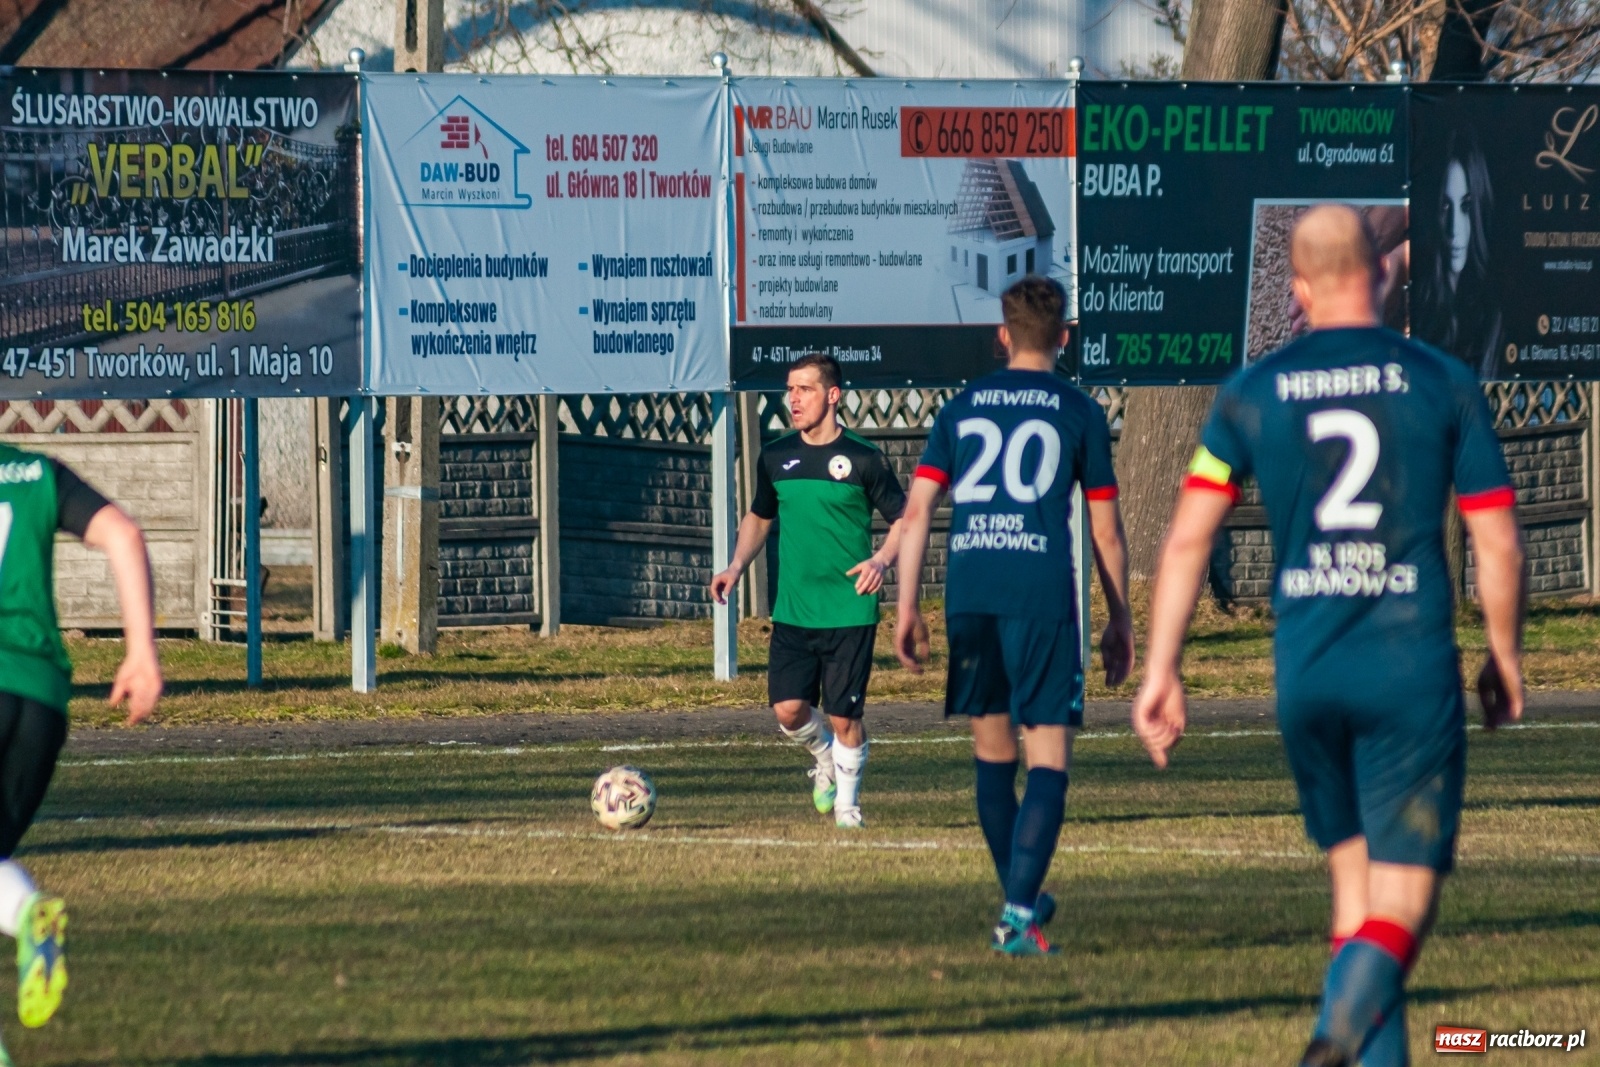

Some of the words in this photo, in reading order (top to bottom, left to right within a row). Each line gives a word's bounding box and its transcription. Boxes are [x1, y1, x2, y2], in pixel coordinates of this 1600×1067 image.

[11, 87, 319, 128] ŚLUSARSTWO-KOWALSTWO
[747, 106, 773, 129] MR
[776, 106, 812, 130] BAU
[817, 106, 859, 129] Marcin
[862, 106, 898, 129] Rusek
[1298, 103, 1395, 135] TWORKÓW
[938, 111, 974, 154] 666
[981, 111, 1018, 154] 859
[1026, 112, 1063, 154] 250
[1083, 104, 1273, 152] EKO-PELLET
[546, 133, 569, 161] tel.
[572, 134, 598, 162] 604
[602, 135, 629, 162] 507
[632, 135, 658, 162] 320
[773, 138, 813, 153] Budowlane
[1298, 143, 1313, 163] ul.
[1316, 143, 1376, 167] Ogrodowa
[1379, 144, 1394, 163] 61
[420, 162, 500, 183] DAW-BUD
[546, 172, 565, 199] ul.
[567, 168, 619, 199] Główna
[623, 171, 638, 199] 18
[649, 167, 711, 199] Tworków
[758, 174, 813, 193] kompleksowa
[815, 174, 847, 190] budowa
[849, 172, 878, 190] domów
[1083, 164, 1142, 197] BUBA
[1146, 164, 1163, 197] P.
[421, 188, 454, 200] Marcin
[458, 188, 500, 202] Wyszkoni
[758, 199, 802, 216] rozbudowa
[810, 199, 859, 219] przebudowa
[861, 198, 902, 220] budynków
[904, 199, 959, 219] mieszkalnych
[62, 226, 146, 263] Marek
[151, 226, 274, 263] Zawadzki
[758, 227, 792, 245] remonty
[801, 224, 854, 245] wykończenia
[409, 253, 482, 282] Docieplenia
[485, 251, 549, 282] budynków
[592, 254, 647, 281] Wynajem
[650, 251, 713, 279] rusztowań
[759, 253, 777, 267] oraz
[779, 252, 796, 267] inne
[799, 252, 823, 271] usługi
[825, 253, 871, 267] remontowo
[879, 251, 923, 267] budowlane
[1083, 245, 1153, 280] Możliwy
[1157, 248, 1234, 280] transport
[759, 277, 793, 297] projekty
[795, 276, 839, 293] budowlane
[1083, 283, 1105, 312] do
[1109, 283, 1164, 312] klienta
[82, 299, 119, 332] tel.
[125, 302, 167, 332] 504
[174, 302, 211, 332] 165
[216, 301, 256, 332] 816
[411, 299, 497, 327] Kompleksowe
[592, 298, 648, 325] Wynajem
[651, 298, 696, 329] sprzętu
[759, 301, 787, 318] nadzór
[789, 303, 834, 321] budowlany
[411, 330, 492, 357] wykończenia
[495, 331, 537, 362] wnętrz
[593, 330, 674, 355] budowlanego
[752, 347, 763, 362] 47
[770, 346, 784, 362] 451
[833, 345, 870, 362] Piaskowa
[871, 346, 882, 361] 34
[1083, 333, 1110, 366] tel.
[1116, 333, 1152, 365] 785
[1158, 333, 1192, 365] 742
[1198, 333, 1233, 365] 974
[2, 347, 77, 377] 47-451
[84, 345, 190, 381] Tworków,
[197, 346, 224, 377] ul.
[231, 346, 241, 376] 1
[249, 345, 302, 383] Maja
[308, 345, 333, 375] 10
[1275, 365, 1381, 401] HERBER
[971, 389, 1060, 411] NIEWIERA
[954, 417, 1061, 504] 20
[1306, 407, 1384, 532] 2
[967, 514, 987, 532] KS
[989, 513, 1024, 532] 1905
